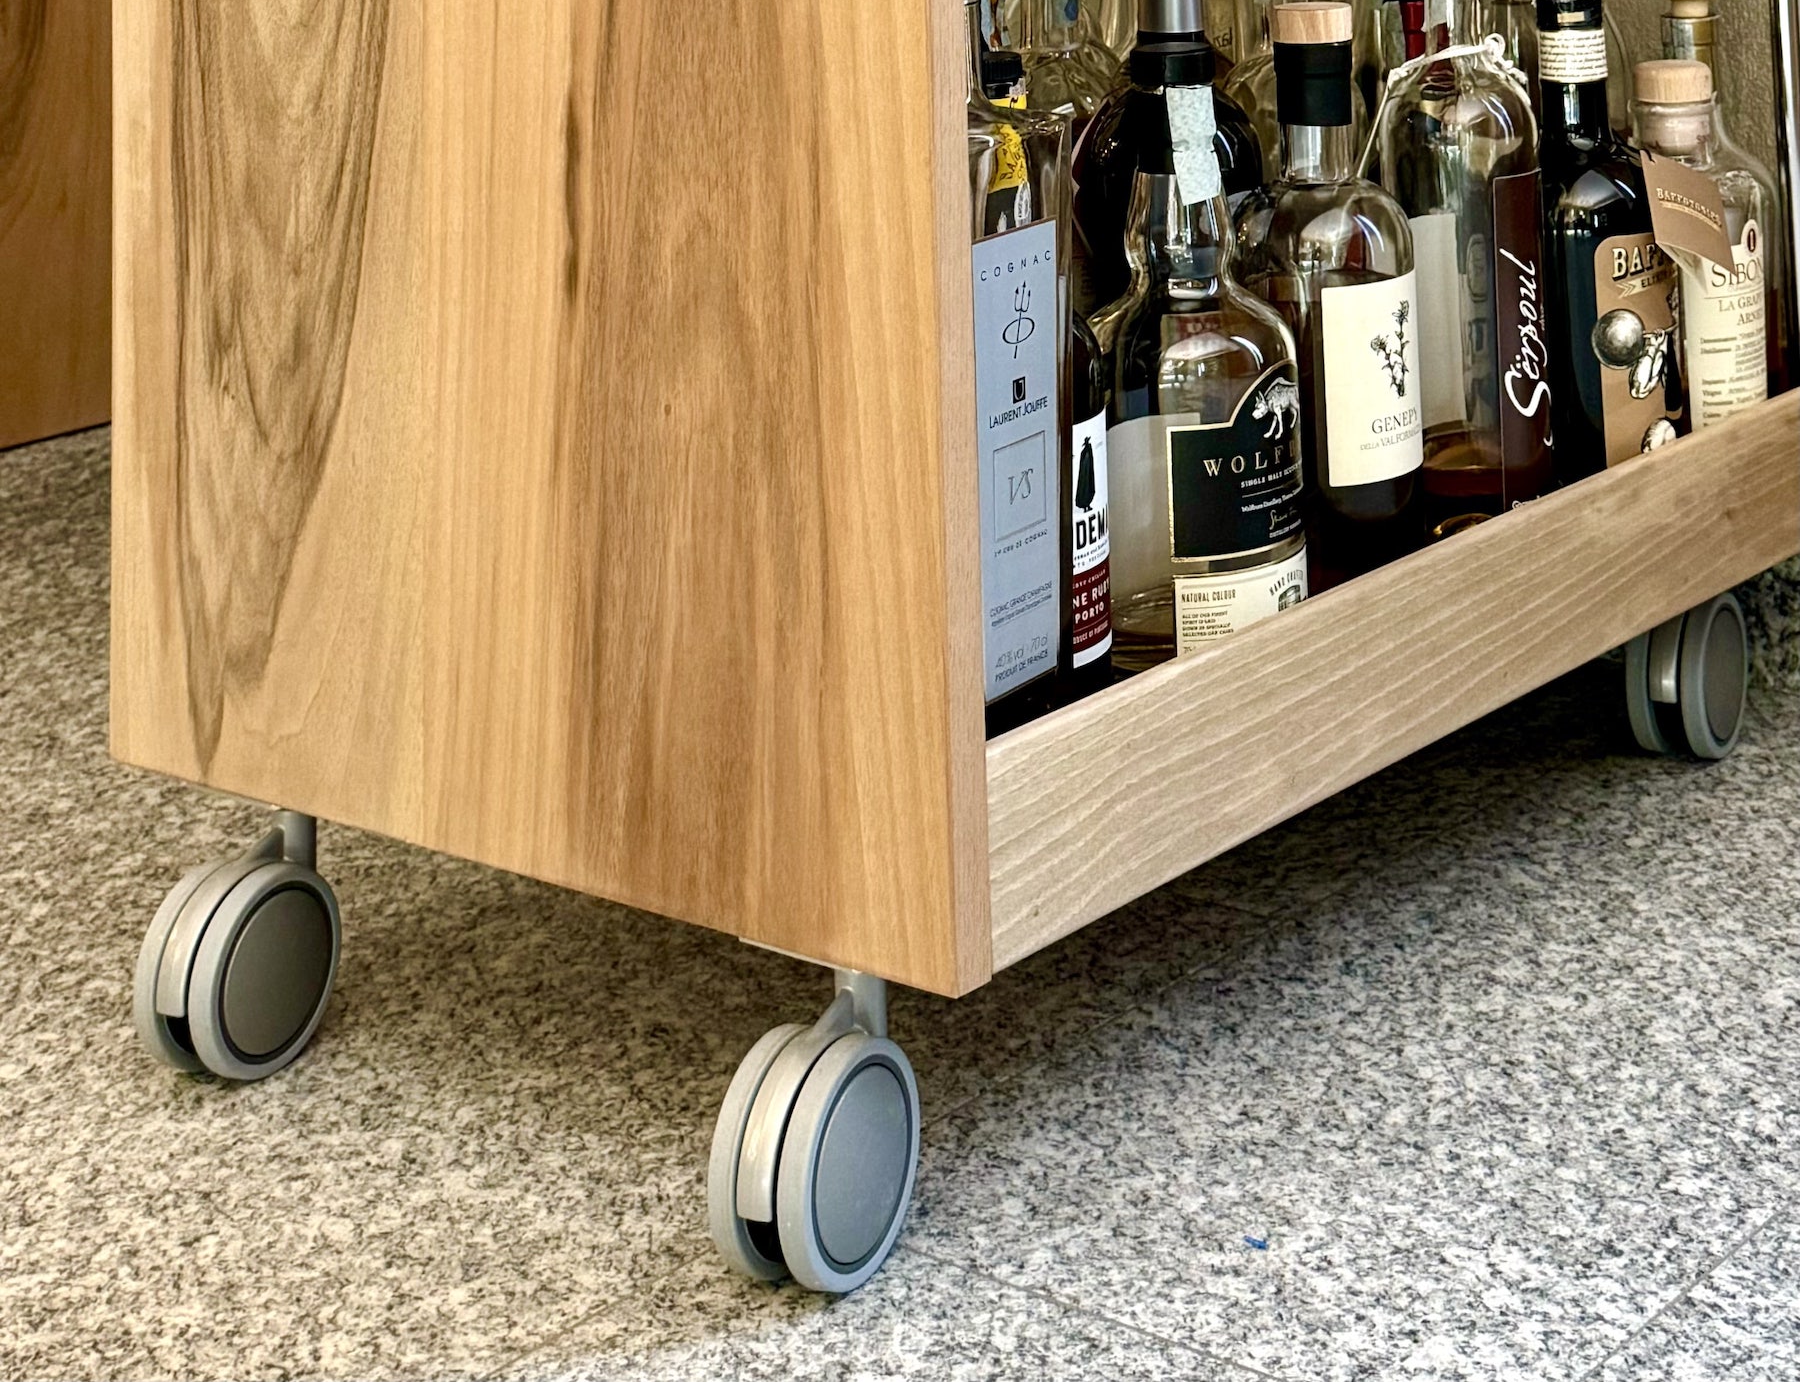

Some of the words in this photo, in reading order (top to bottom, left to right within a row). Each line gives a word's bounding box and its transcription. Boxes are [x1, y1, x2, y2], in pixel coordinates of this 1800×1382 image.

[980, 250, 1051, 281] COGNAC
[1611, 243, 1665, 282] BAF
[1719, 299, 1735, 312] LA
[989, 406, 1021, 429] LAURENT
[1022, 396, 1048, 416] JOUFFE
[1008, 467, 1034, 506] VS
[1240, 477, 1265, 488] SINGLE
[1267, 471, 1283, 481] MALT
[1181, 592, 1210, 603] NATURAL
[1211, 589, 1236, 601] COLOUR
[1075, 601, 1105, 624] PORTO
